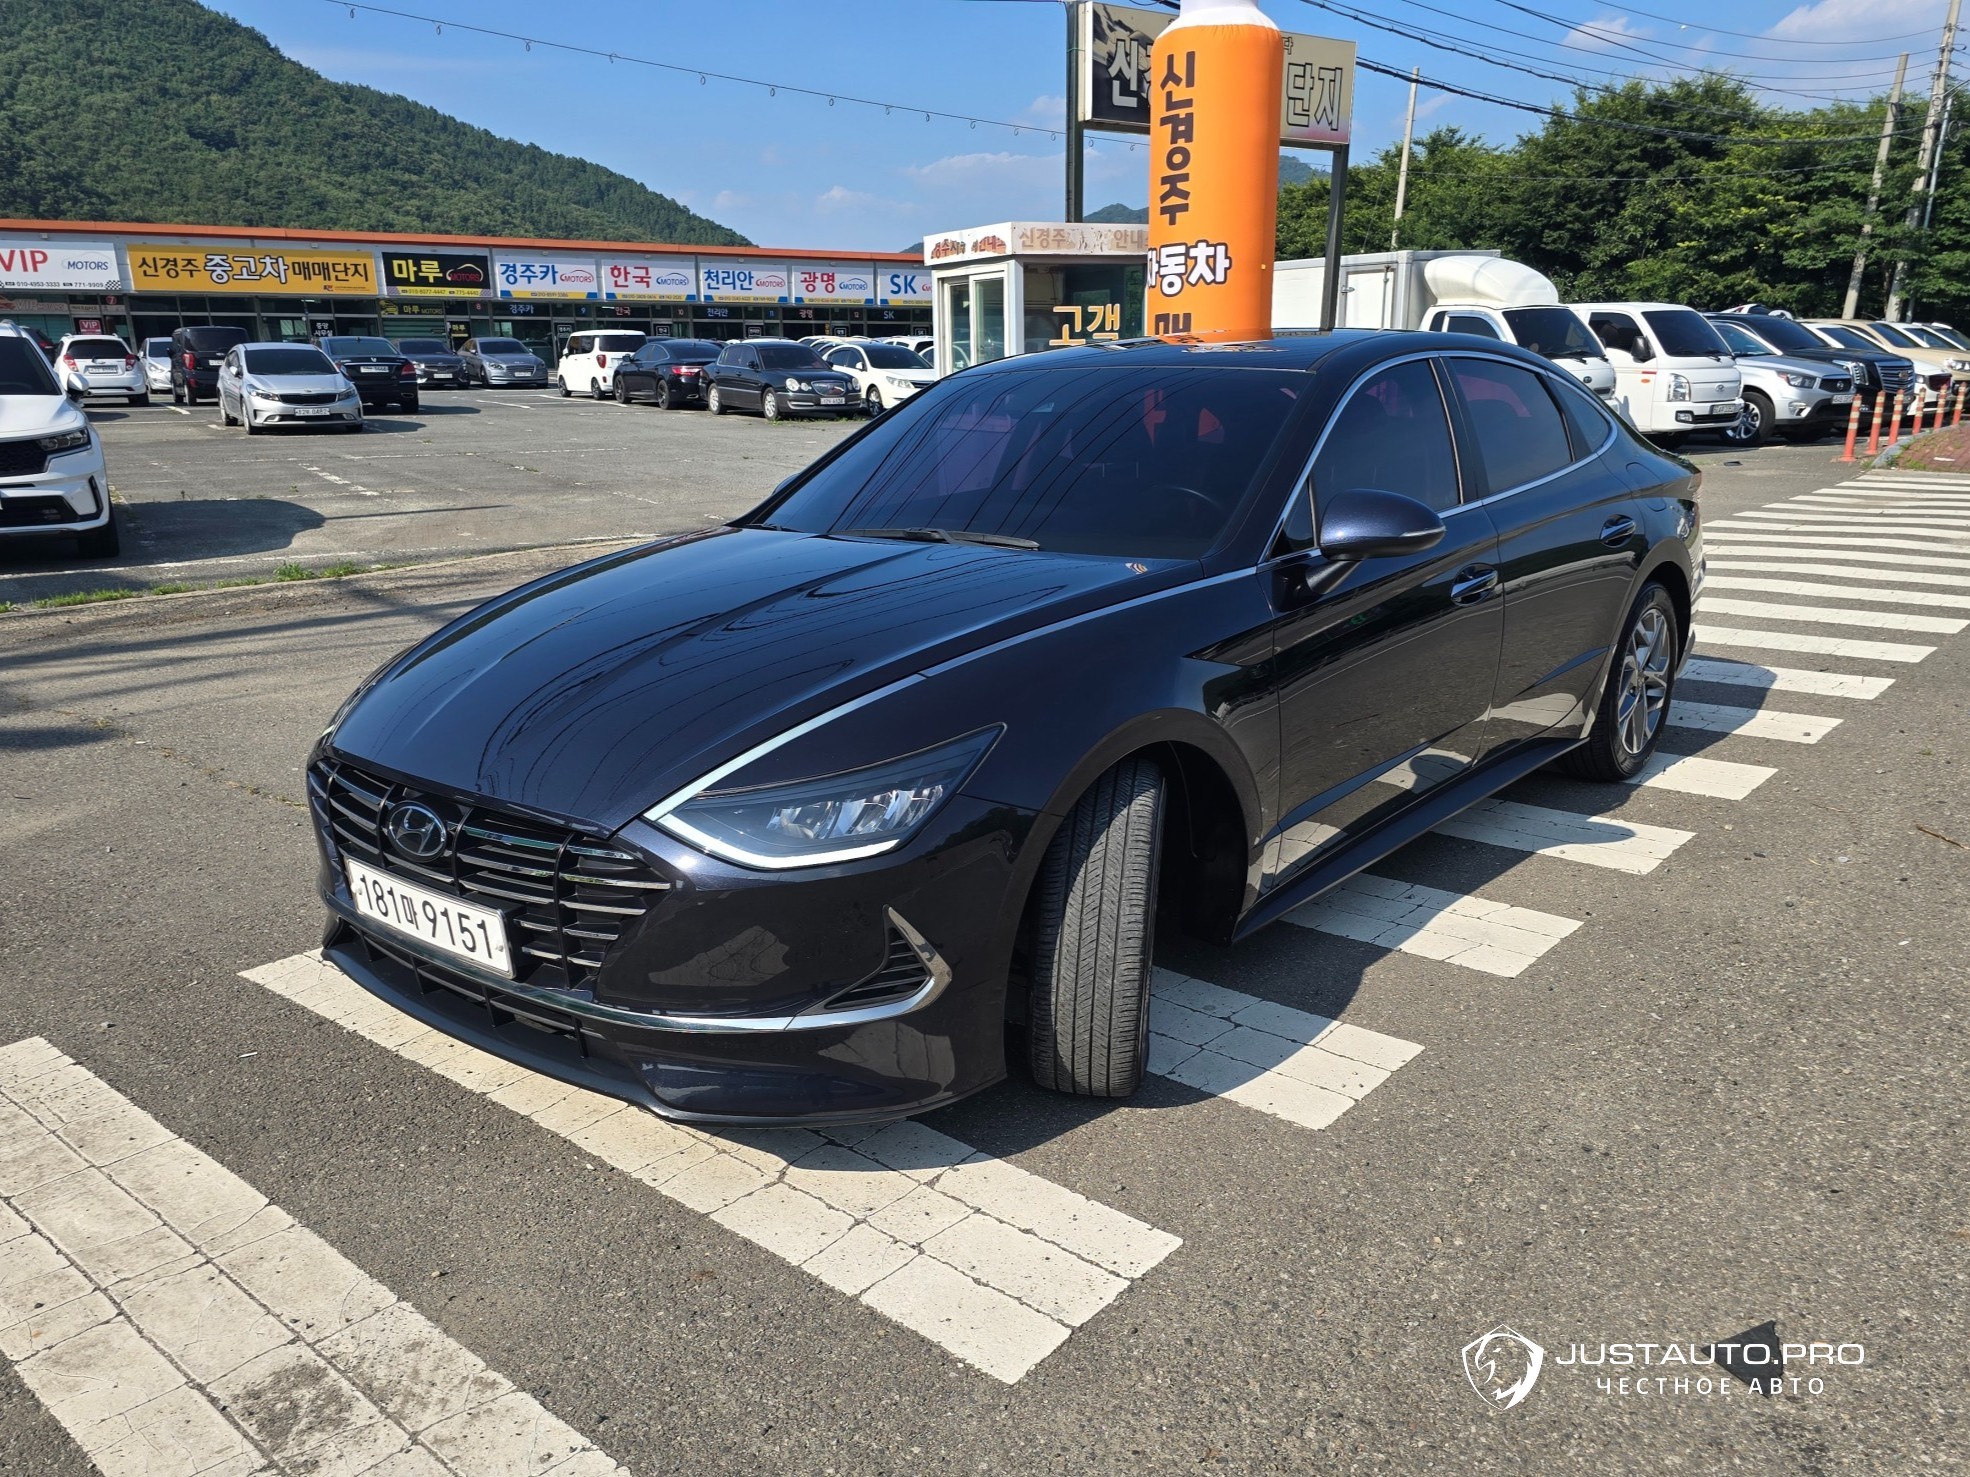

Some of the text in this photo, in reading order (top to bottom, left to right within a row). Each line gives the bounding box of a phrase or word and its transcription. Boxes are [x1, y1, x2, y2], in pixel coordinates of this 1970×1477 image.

[1286, 62, 1343, 131] 단지
[1160, 51, 1195, 226] 신경주
[0, 250, 109, 272] VIP MOTORS
[138, 254, 369, 284] 신경주 중고차 매매단지
[392, 259, 481, 283] 마루 MOTORS
[500, 263, 592, 285] 경주카 MOTORS
[610, 265, 688, 288] 한국 MOTORS
[704, 268, 784, 291] 천리안 MOTORS
[800, 271, 867, 294] 광명 MOTORS
[890, 274, 917, 295] SK
[403, 305, 420, 315] 마루
[510, 304, 534, 314] 경주카
[706, 308, 728, 317] 천리안
[883, 310, 895, 320] SK
[81, 321, 98, 329] VIP
[1049, 303, 1120, 345] 고객
[359, 873, 493, 959] 181마9151
